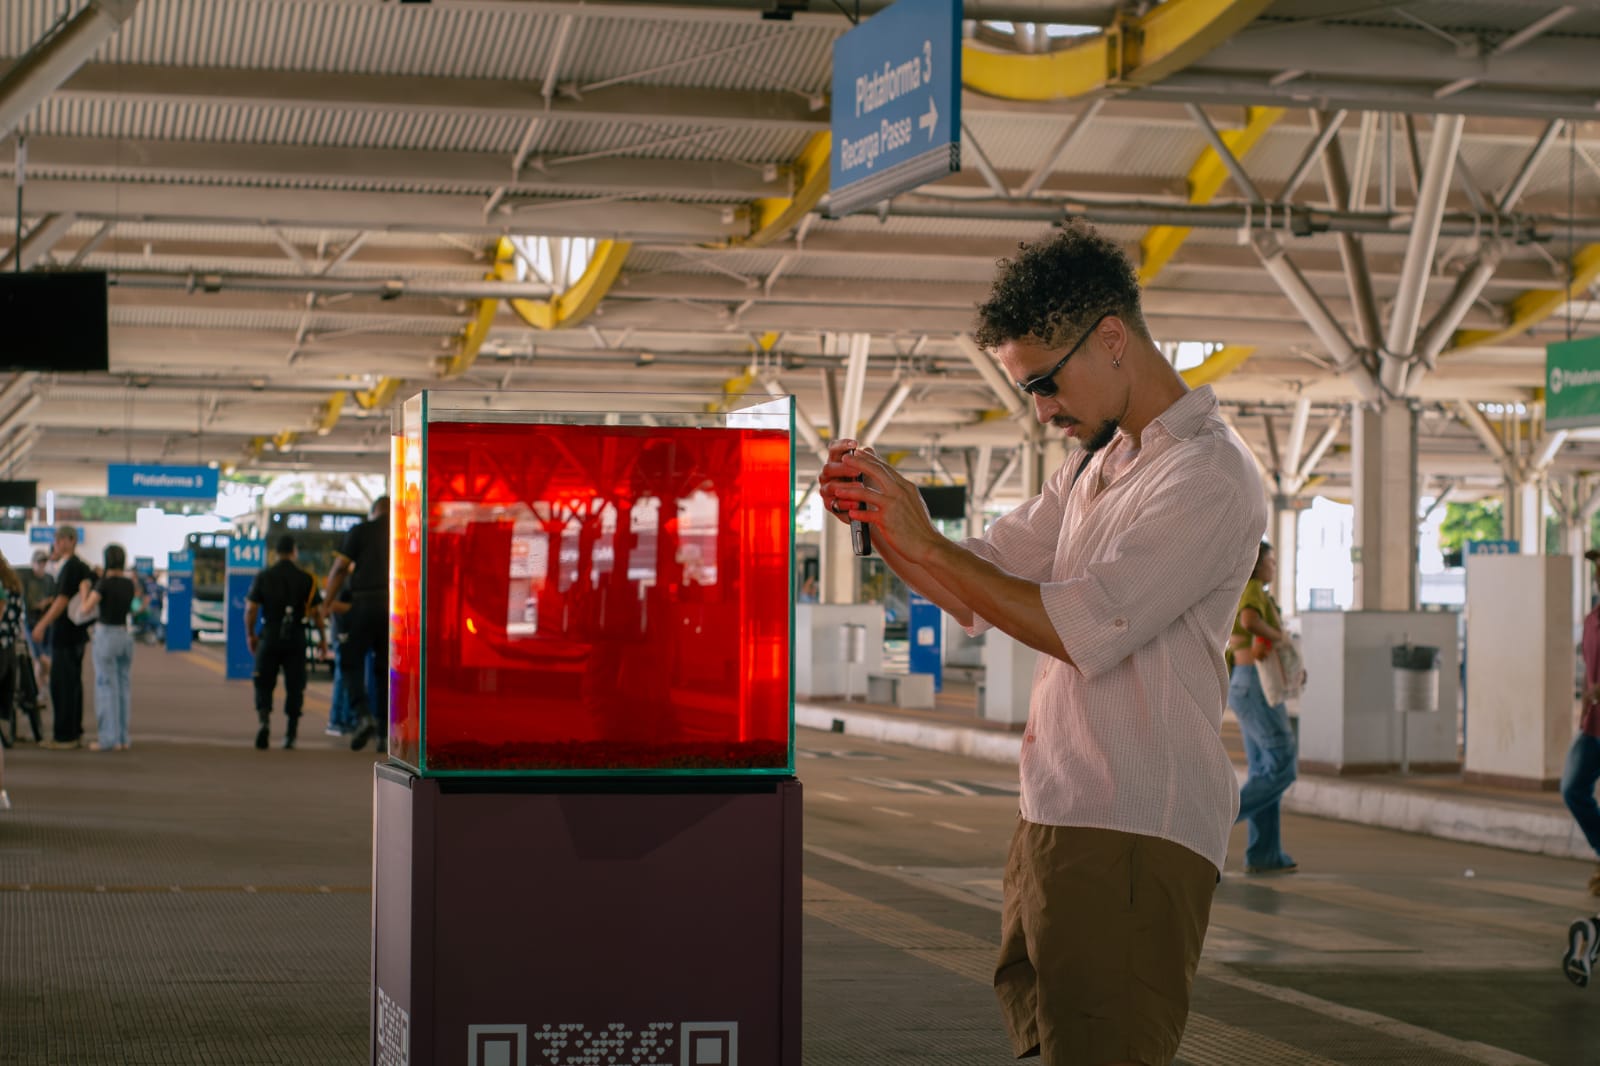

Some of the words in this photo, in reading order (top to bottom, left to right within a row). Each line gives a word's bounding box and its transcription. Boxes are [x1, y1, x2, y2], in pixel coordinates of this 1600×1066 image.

[855, 57, 921, 119] Plataforma
[923, 39, 932, 84] 3
[841, 131, 880, 172] Recarga
[881, 117, 912, 154] Passe
[133, 473, 194, 488] Plataforma
[233, 544, 260, 562] 141
